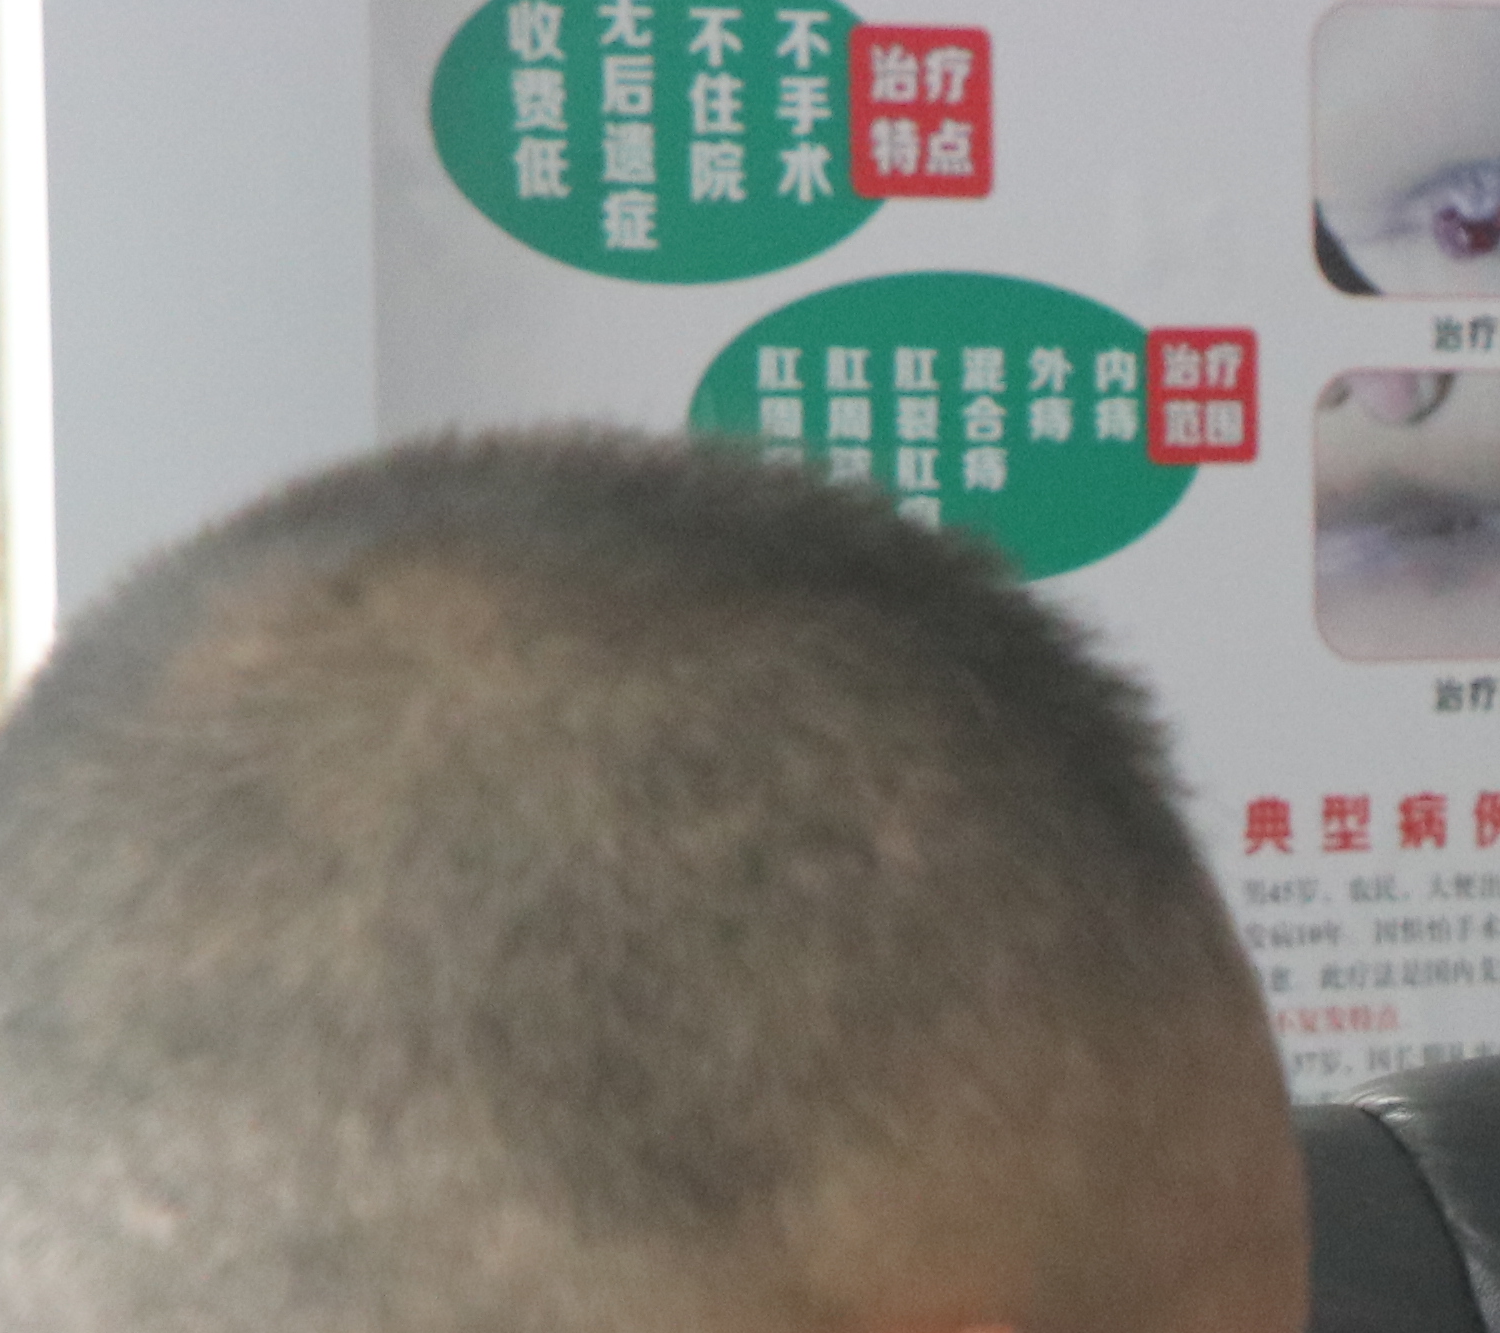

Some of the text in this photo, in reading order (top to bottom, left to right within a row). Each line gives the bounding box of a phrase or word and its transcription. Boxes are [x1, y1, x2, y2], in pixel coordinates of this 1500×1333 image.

[508, 2, 571, 199] 收费低
[689, 9, 746, 202] 不住院
[777, 9, 833, 202] 不手术
[871, 44, 973, 103] 治疗
[602, 0, 660, 250] 无后遗症
[871, 118, 974, 176] 特点
[1028, 347, 1073, 442] 外痔
[1095, 347, 1139, 442] 内痔
[1163, 342, 1244, 389] 治疗
[1164, 400, 1244, 446] 范围
